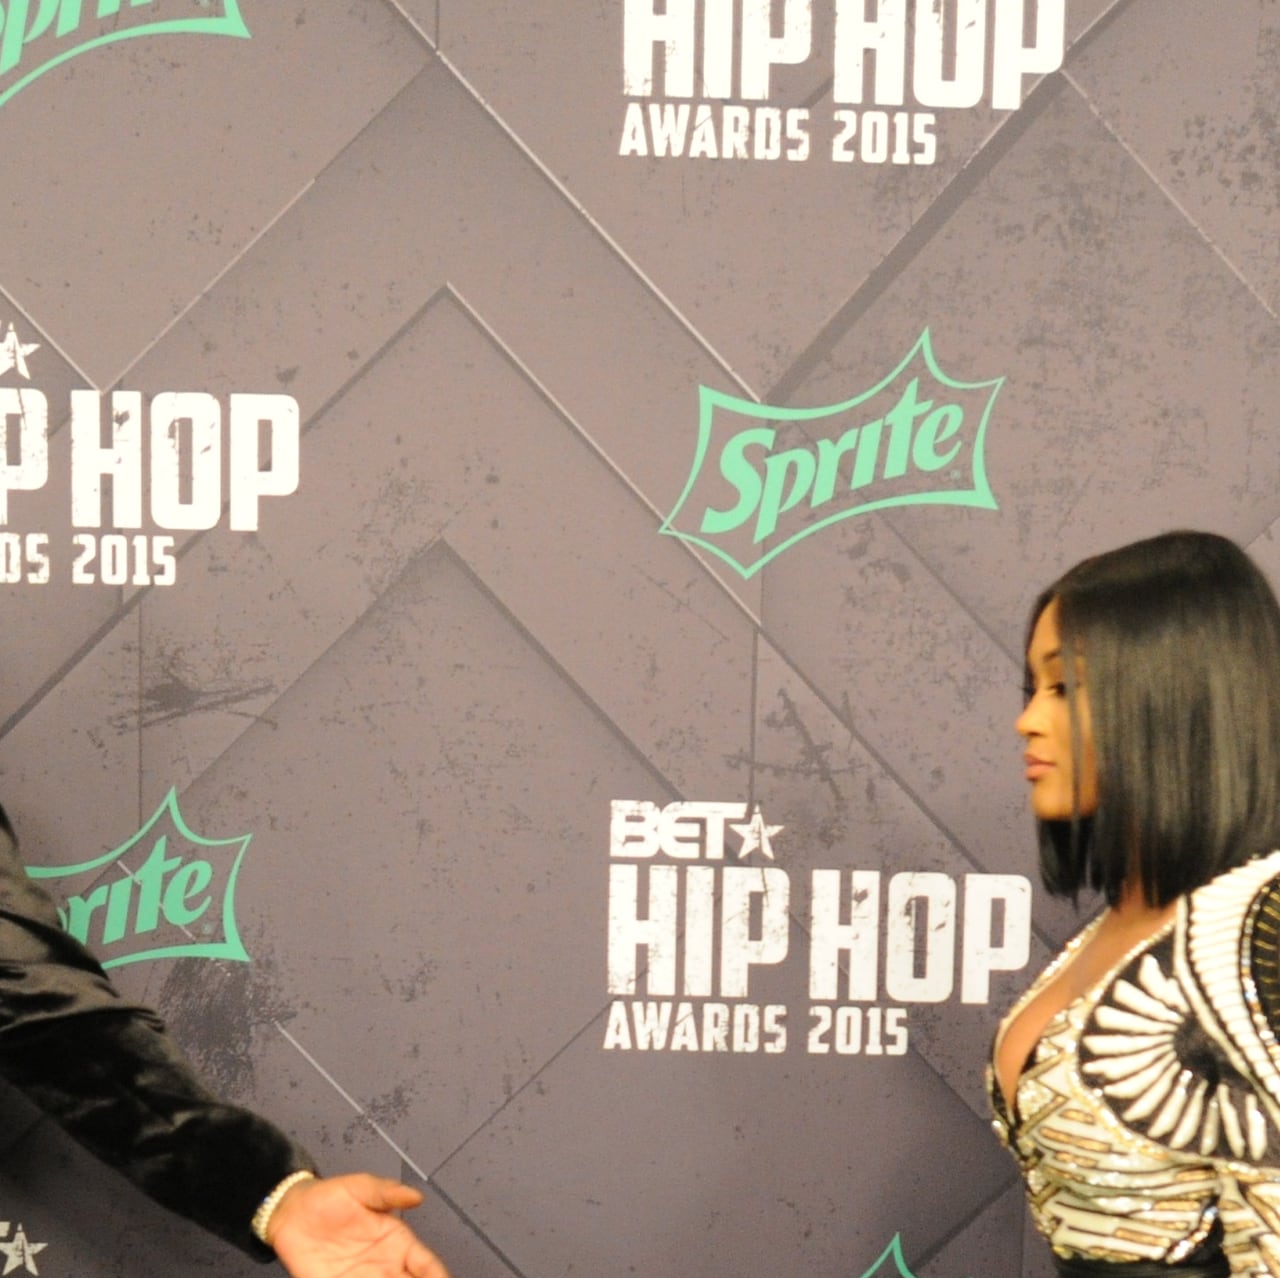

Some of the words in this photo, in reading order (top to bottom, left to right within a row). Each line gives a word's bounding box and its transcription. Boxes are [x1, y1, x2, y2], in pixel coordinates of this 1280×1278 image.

[622, 0, 813, 101] HIP
[832, 0, 1066, 111] HOP
[618, 101, 811, 162] AWARDS
[831, 109, 937, 166] 2015
[70, 388, 301, 532] HOP
[699, 377, 966, 544] Sprite
[71, 533, 177, 587] 2015
[609, 799, 748, 860] BET
[56, 834, 214, 946] rite
[607, 863, 791, 998] HIP
[809, 868, 1032, 1004] HOP
[603, 1000, 787, 1054] AWARDS
[807, 1005, 908, 1056] 2015
